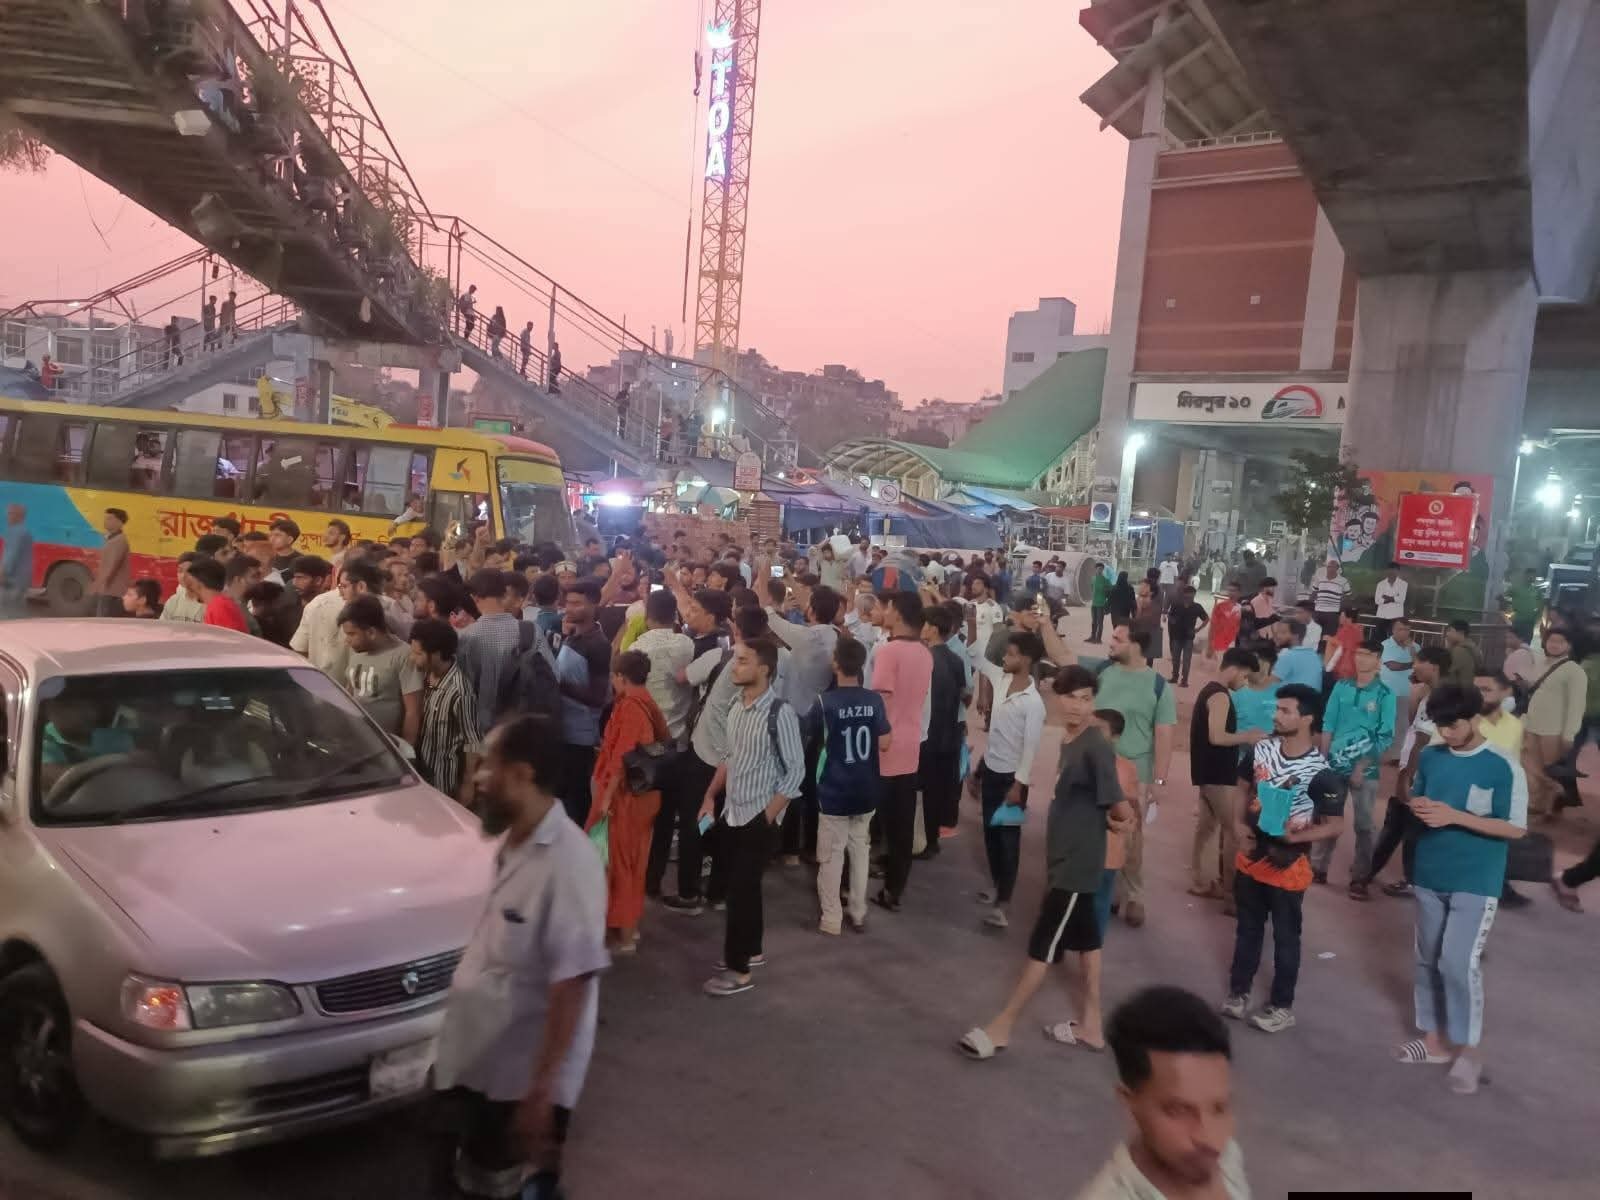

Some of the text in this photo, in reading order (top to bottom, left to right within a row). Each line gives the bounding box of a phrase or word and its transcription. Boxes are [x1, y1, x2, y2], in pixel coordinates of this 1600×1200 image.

[1177, 390, 1251, 413] মিরপুর ১০
[839, 705, 874, 719] RAZIB
[841, 725, 871, 764] 10
